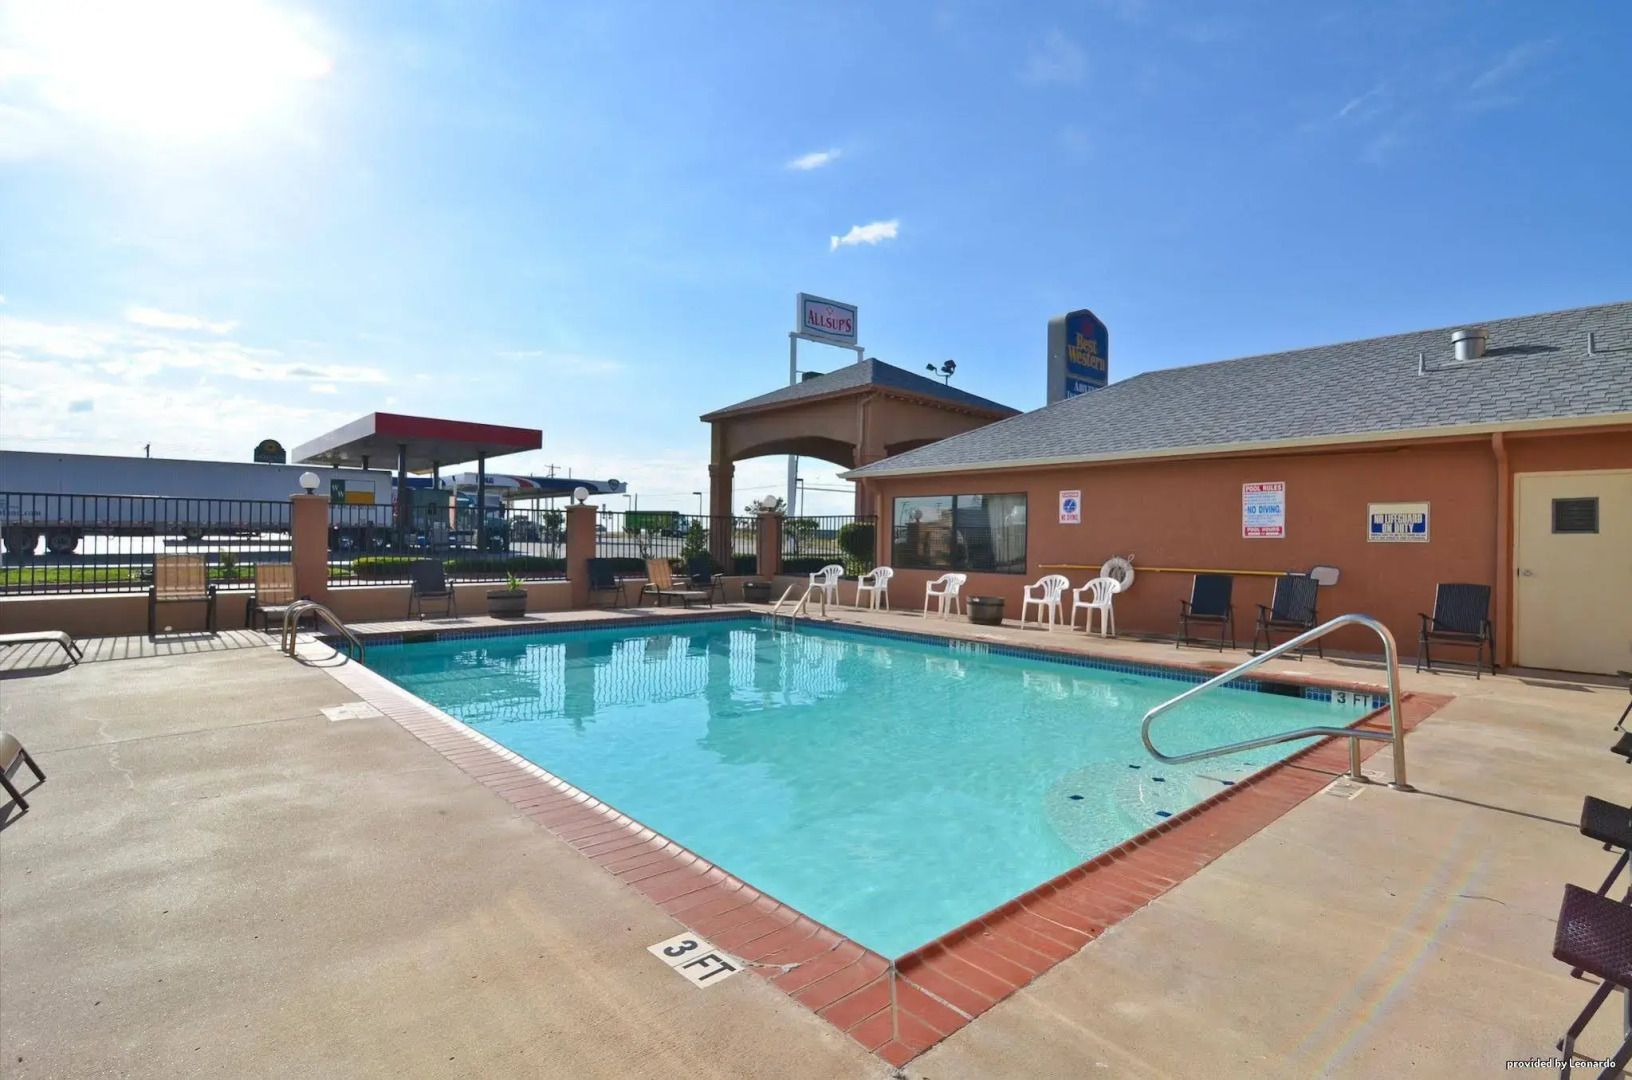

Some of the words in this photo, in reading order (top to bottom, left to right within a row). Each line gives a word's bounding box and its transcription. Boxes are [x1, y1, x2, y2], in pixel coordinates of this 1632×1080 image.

[1076, 332, 1097, 355] Best
[1067, 344, 1106, 372] Western
[1247, 505, 1256, 514] NO
[1373, 513, 1384, 523] NO
[1384, 513, 1423, 523] LIFEGUARD
[1382, 523, 1392, 533] ON
[1394, 523, 1413, 533] DUTY
[1337, 692, 1346, 704] 3
[1353, 694, 1370, 707] FT
[663, 940, 698, 957] 3
[682, 954, 737, 981] FT
